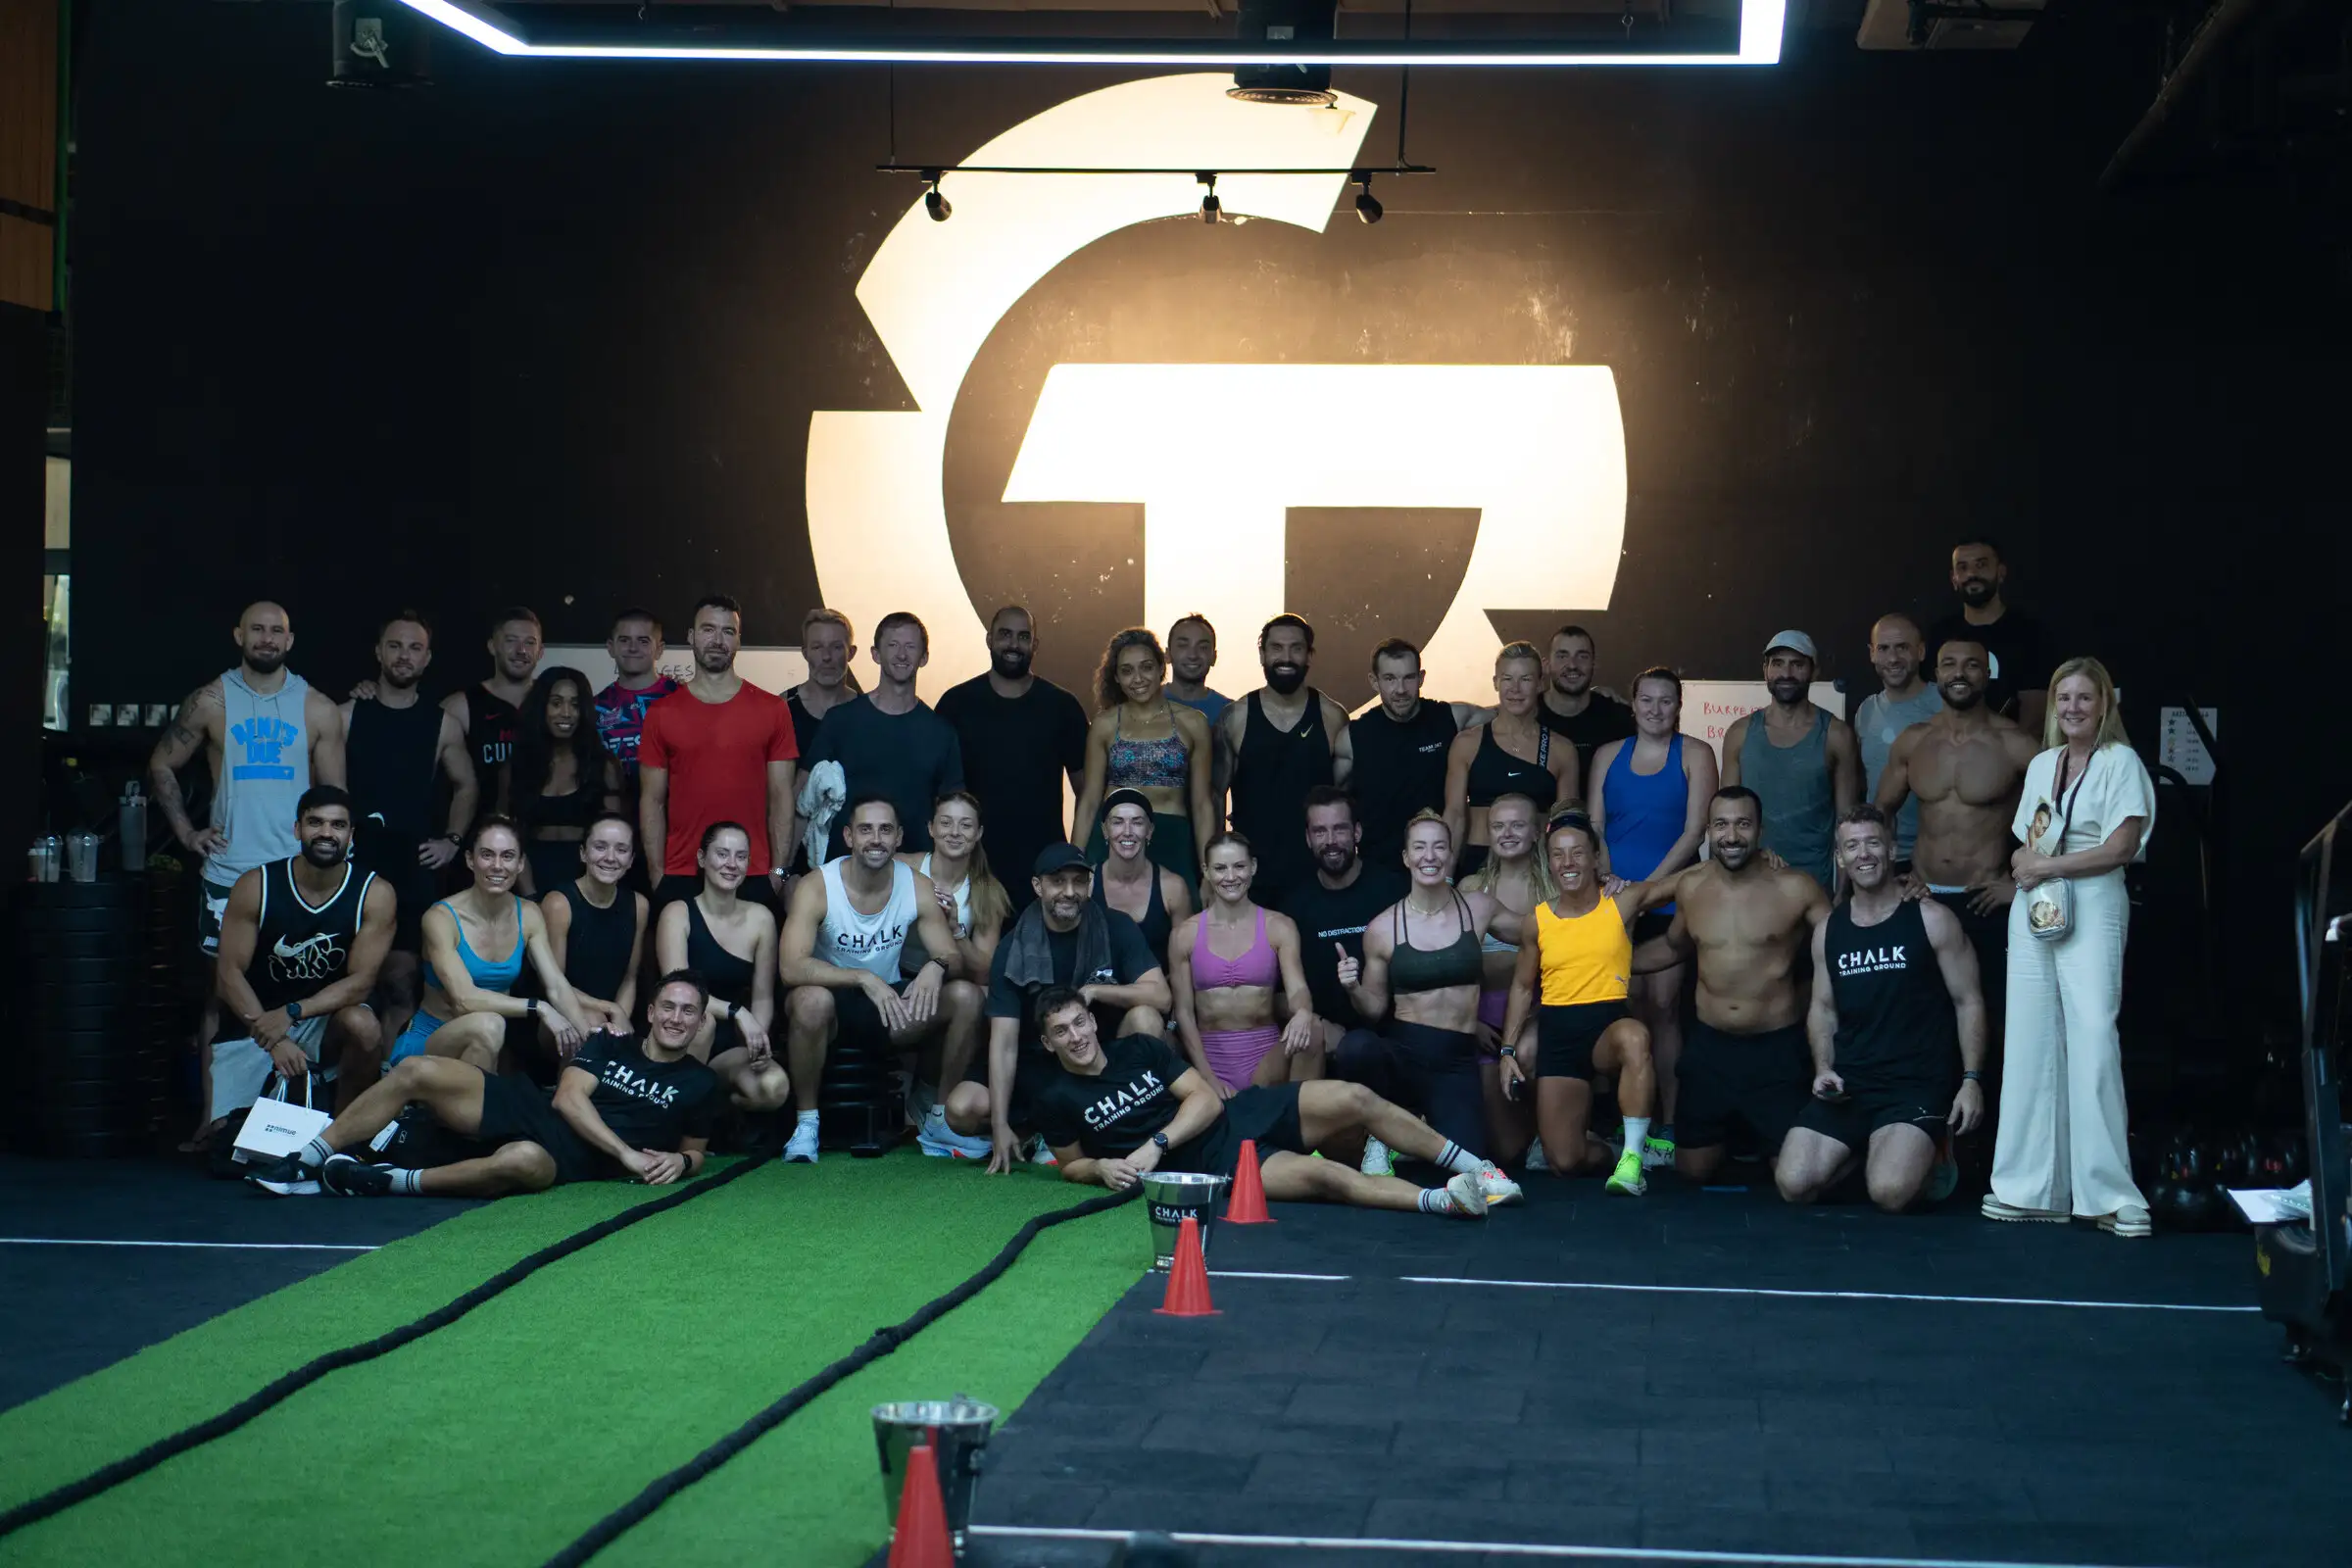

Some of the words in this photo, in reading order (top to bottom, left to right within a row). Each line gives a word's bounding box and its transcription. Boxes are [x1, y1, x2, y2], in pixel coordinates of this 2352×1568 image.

[247, 741, 281, 763] DUE
[837, 924, 903, 948] CHALK
[1838, 945, 1908, 969] CHALK
[1838, 966, 1872, 977] TRAINING
[1873, 962, 1907, 971] GROUND
[604, 1059, 680, 1103] CHALK
[1084, 1069, 1161, 1125] CHALK
[1093, 1104, 1132, 1133] TRAINING
[1133, 1083, 1165, 1107] GROUND
[1154, 1205, 1199, 1218] CHALK
